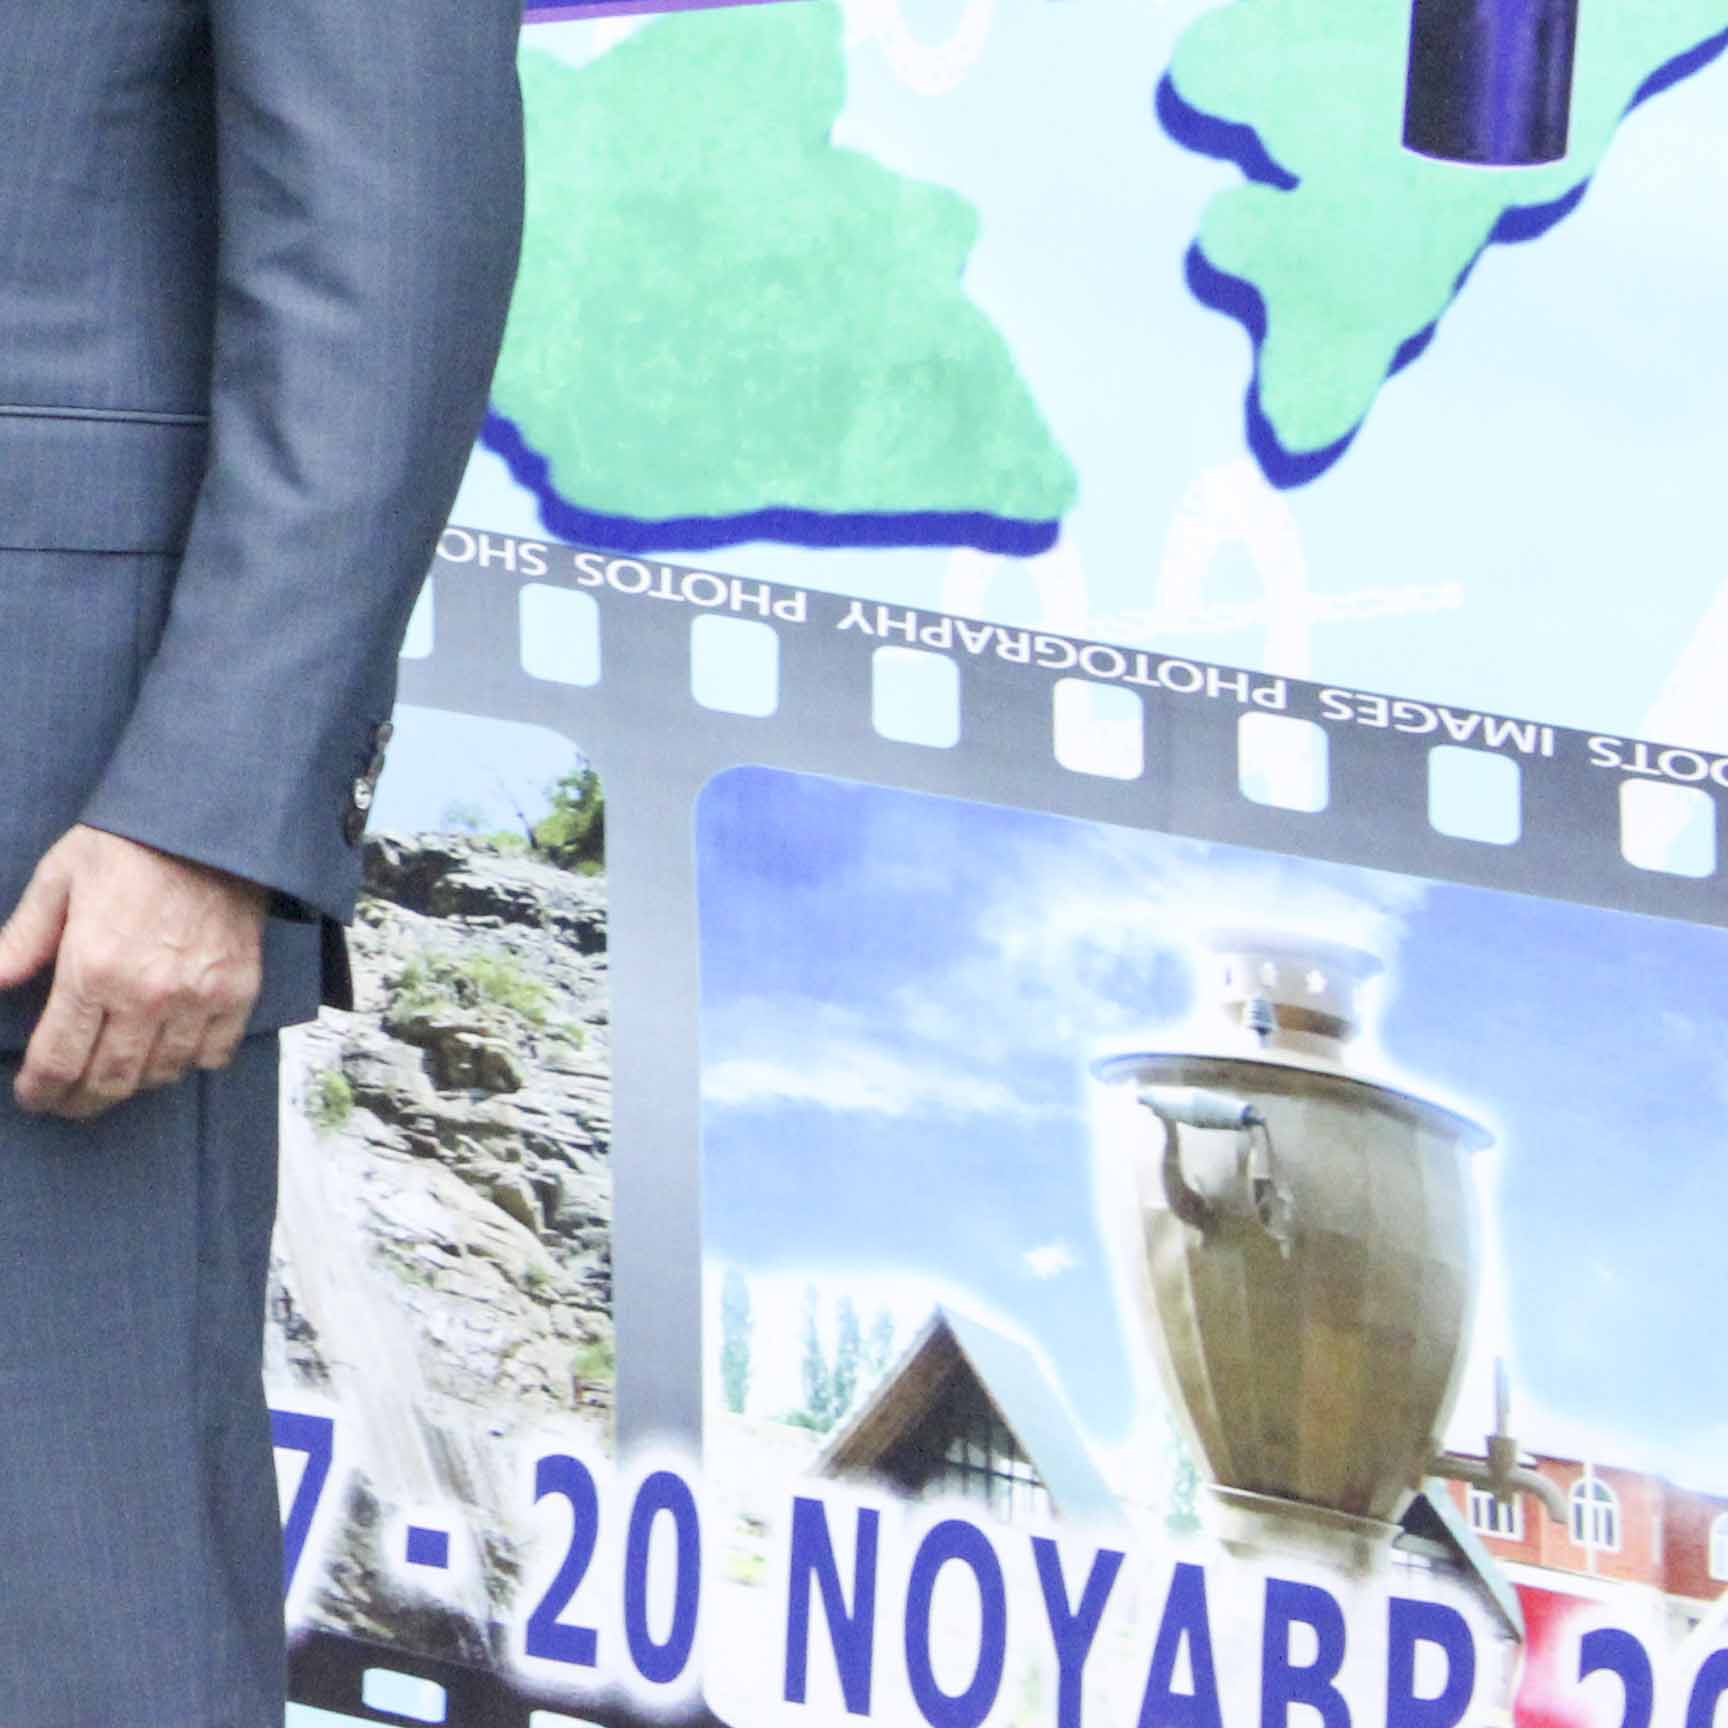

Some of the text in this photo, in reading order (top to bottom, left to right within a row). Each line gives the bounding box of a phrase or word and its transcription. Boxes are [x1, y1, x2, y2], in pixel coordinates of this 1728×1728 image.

[573, 551, 808, 624] PHOTOS
[837, 600, 1289, 710] PHOTOGRAPHY
[1319, 687, 1555, 759] IMAGES
[525, 1453, 701, 1684] 20
